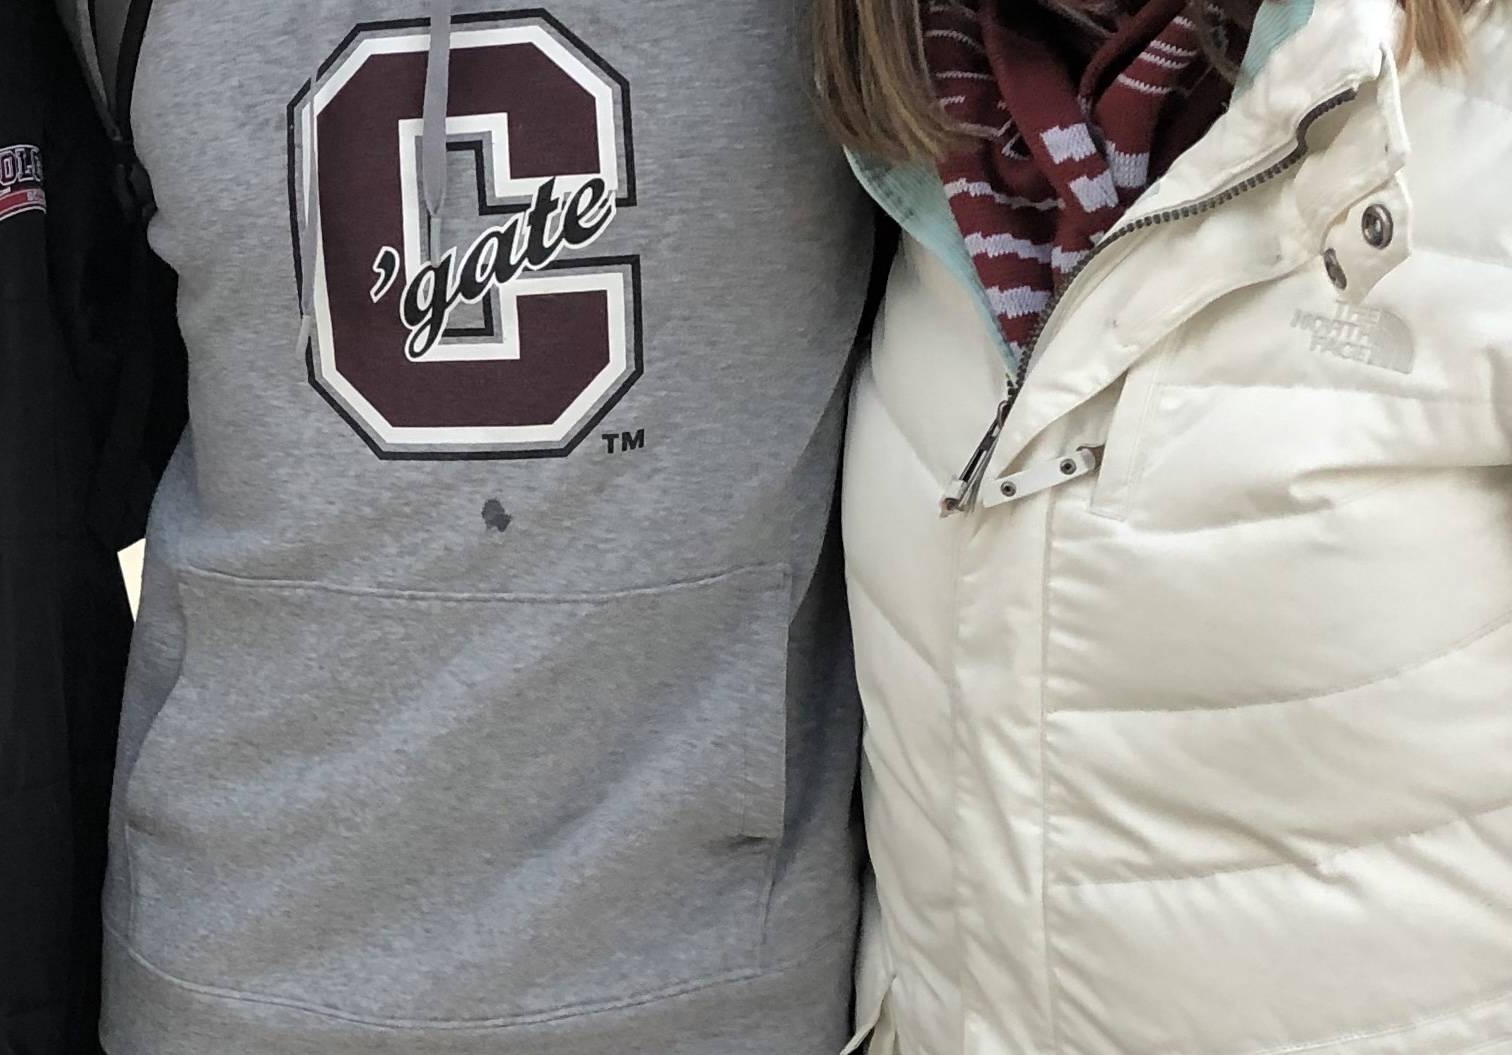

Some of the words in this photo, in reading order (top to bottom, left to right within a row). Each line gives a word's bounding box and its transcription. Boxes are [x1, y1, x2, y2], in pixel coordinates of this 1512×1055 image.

[287, 7, 644, 461] C
[1309, 333, 1372, 364] FACE
[601, 428, 646, 455] TM
